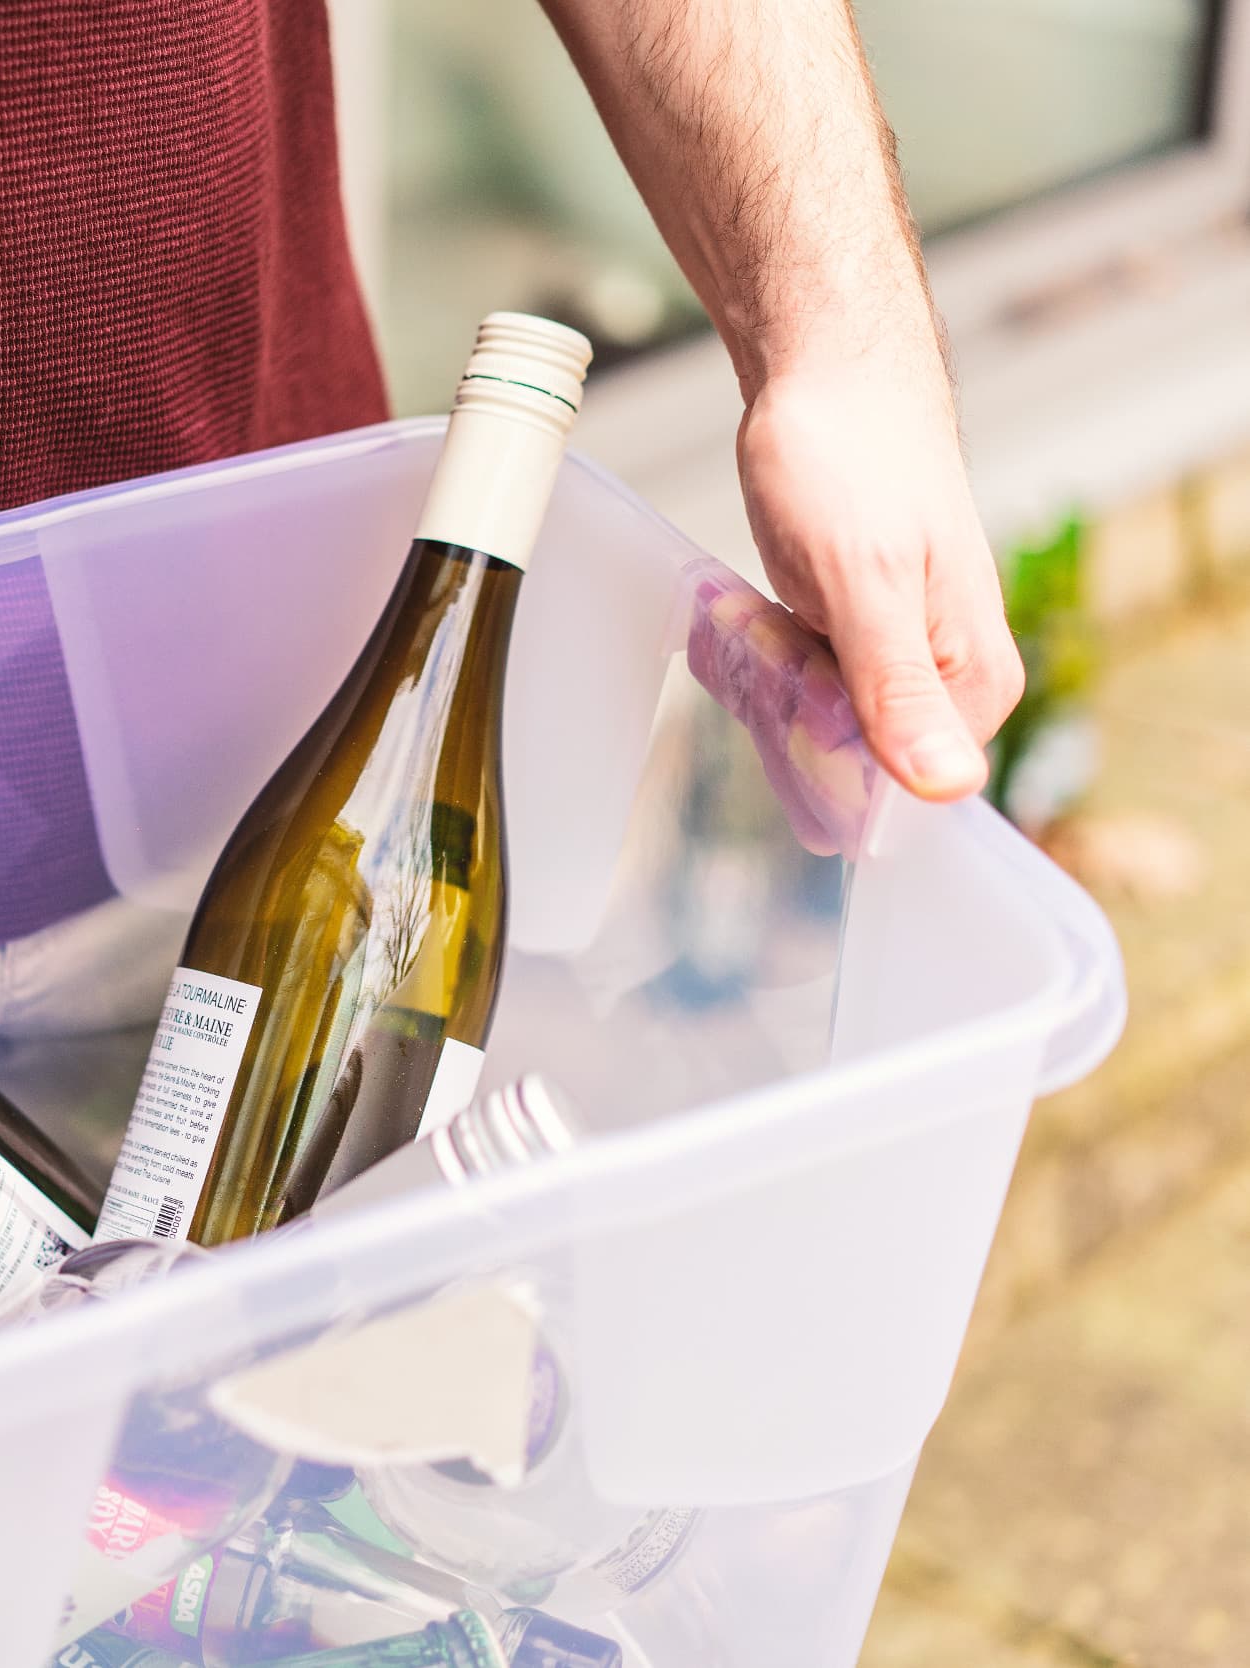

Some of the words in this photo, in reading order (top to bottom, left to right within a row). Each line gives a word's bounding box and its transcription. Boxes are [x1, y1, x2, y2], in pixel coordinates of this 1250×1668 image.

[181, 984, 247, 1015] TOURMALINE
[184, 1011, 192, 1025] &
[193, 1014, 234, 1038] MAINE
[191, 1069, 200, 1077] the
[201, 1072, 216, 1083] heart
[217, 1076, 225, 1085] of
[198, 1083, 221, 1099] Picking
[195, 1096, 201, 1104] to
[203, 1100, 217, 1110] give
[206, 1113, 213, 1121] at
[190, 1120, 209, 1133] before
[185, 1132, 192, 1141] to
[193, 1135, 206, 1145] give
[176, 1168, 195, 1180] meats
[88, 1485, 123, 1539] SOY
[175, 1563, 207, 1622] ASDA
